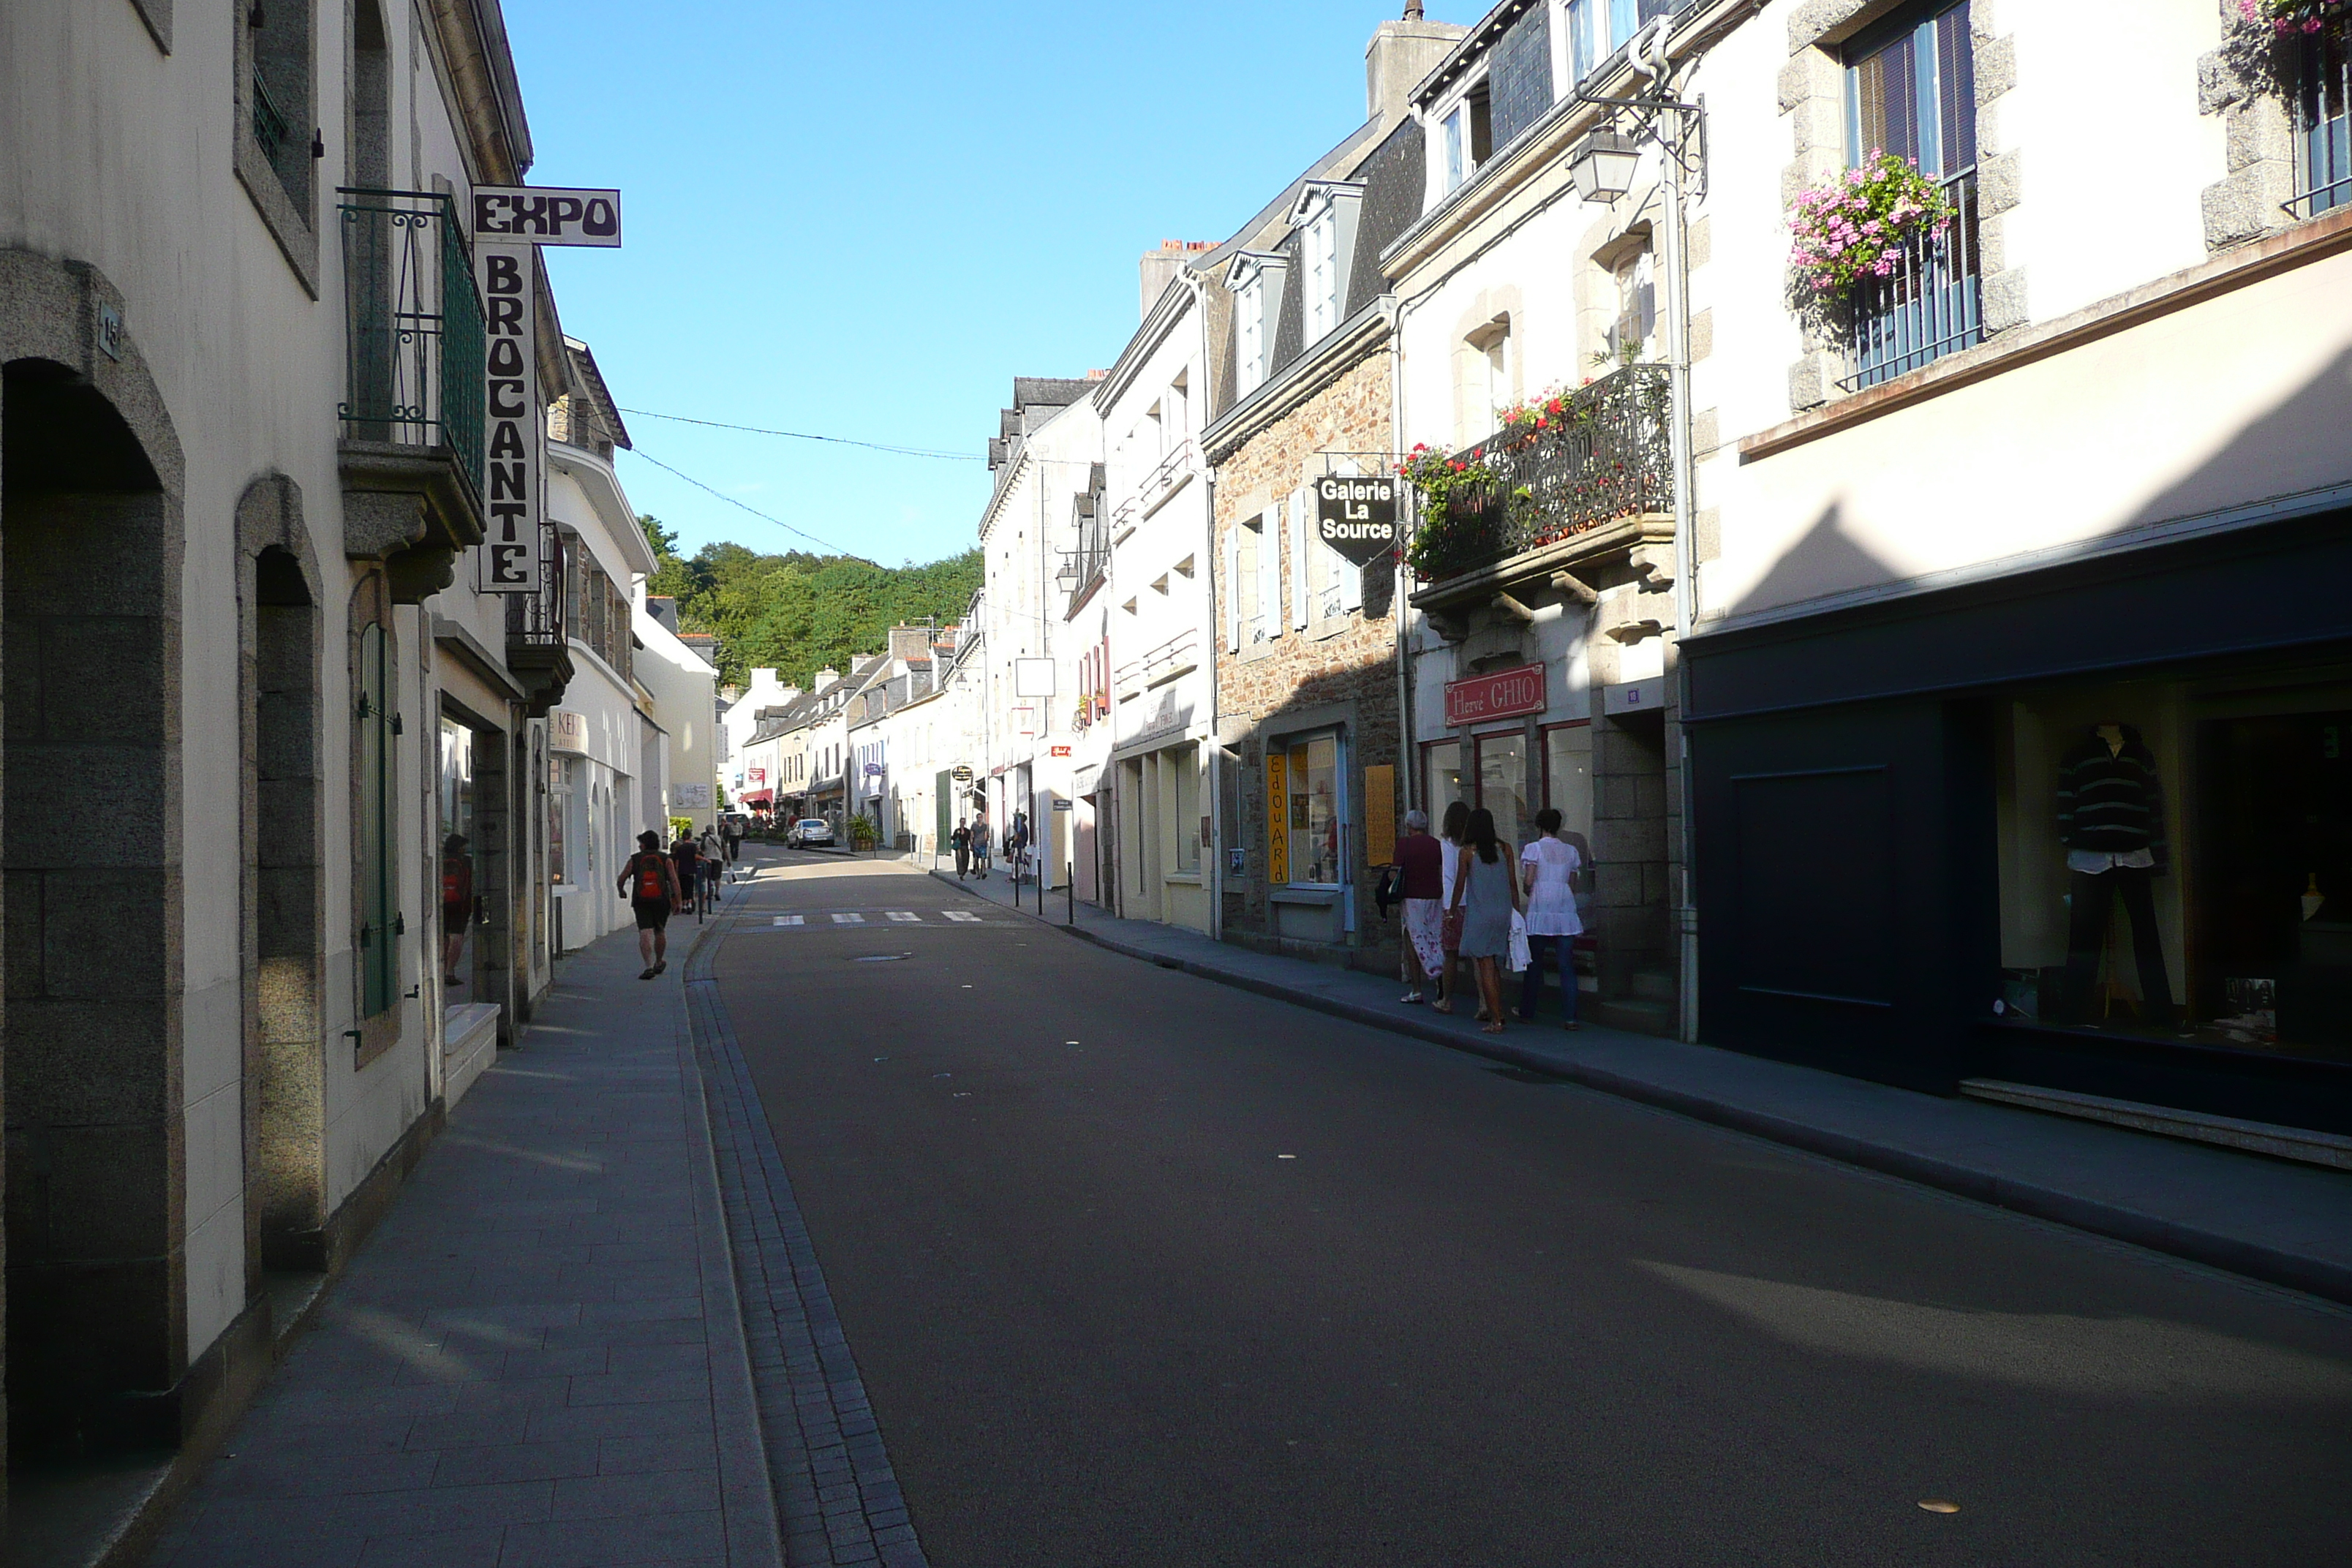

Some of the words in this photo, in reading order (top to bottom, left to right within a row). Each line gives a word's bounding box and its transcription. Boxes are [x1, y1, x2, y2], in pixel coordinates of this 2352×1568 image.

[475, 195, 619, 236] EXPO
[105, 316, 118, 351] 15
[486, 255, 527, 584] BROCANTE
[1321, 480, 1391, 500] Galerie
[1345, 500, 1369, 520] La
[1322, 518, 1392, 539] Source
[1453, 690, 1484, 716] Hervé
[1491, 676, 1534, 709] GHIO
